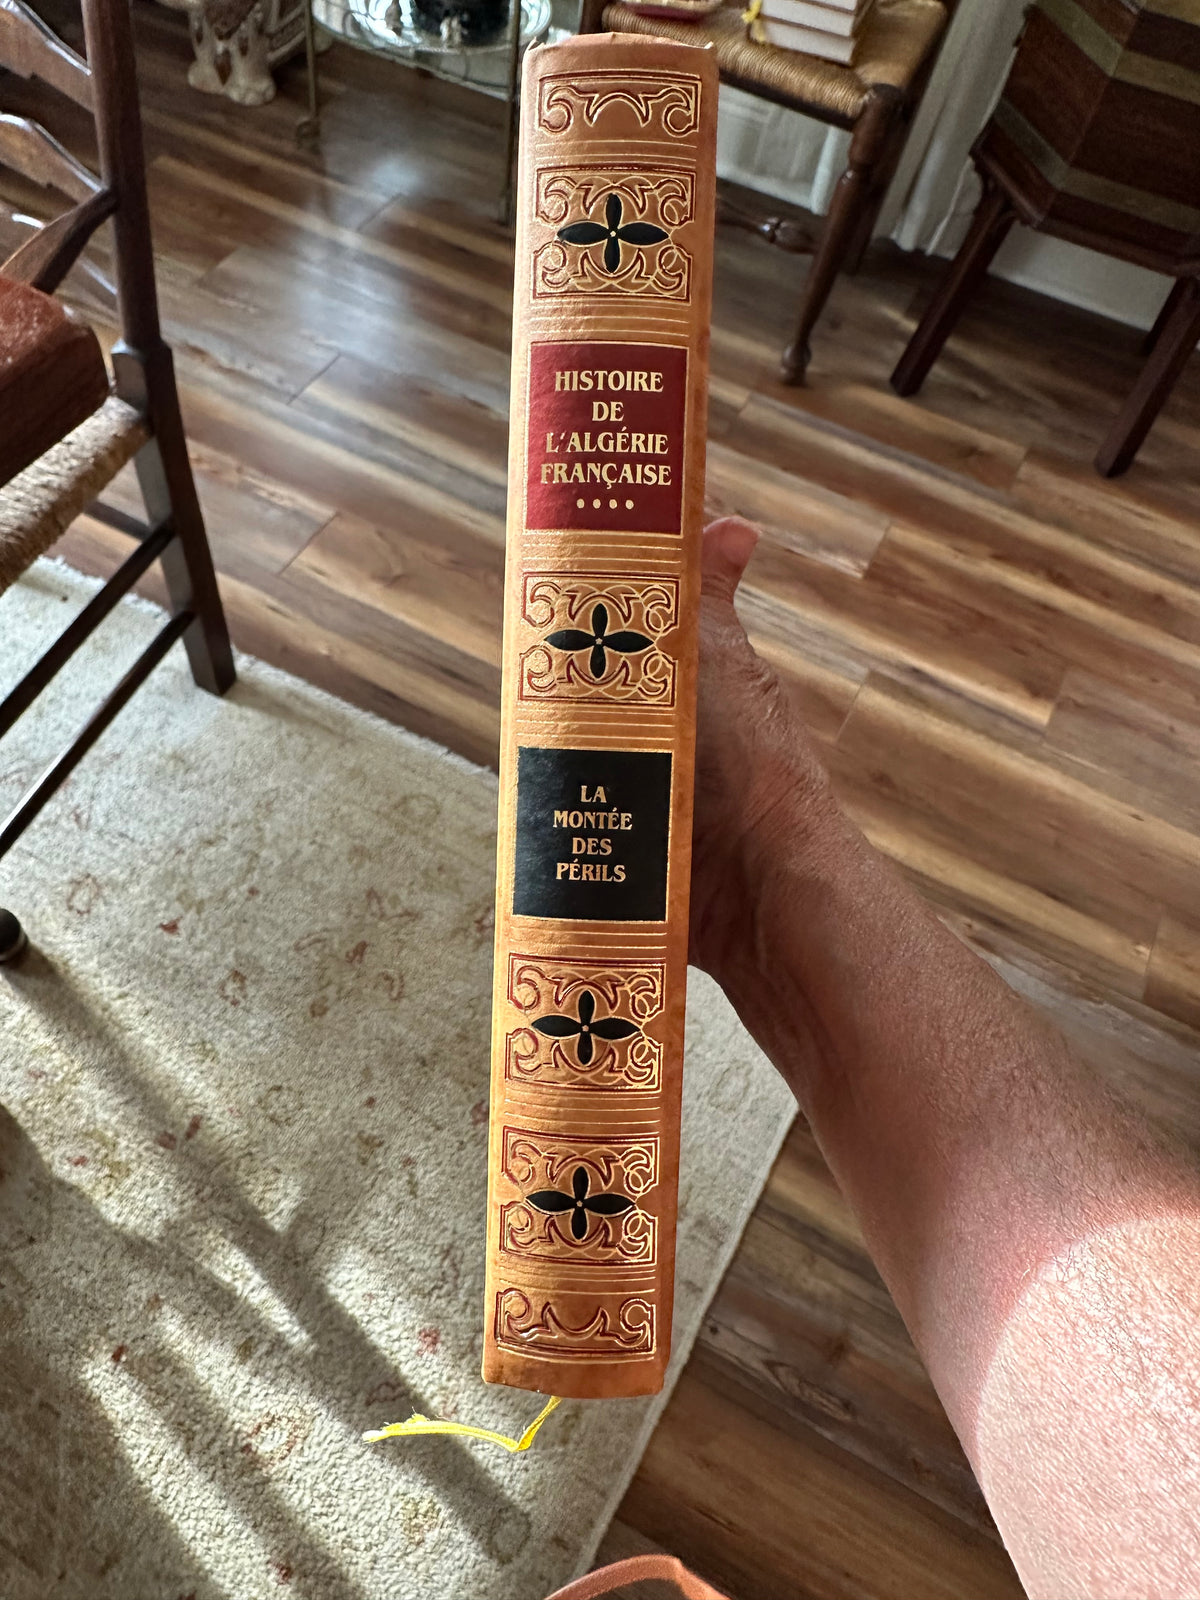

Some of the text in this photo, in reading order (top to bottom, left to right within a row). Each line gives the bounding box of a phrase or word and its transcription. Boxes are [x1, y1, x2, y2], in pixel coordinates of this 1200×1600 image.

[555, 370, 664, 393] HISTOIRE
[592, 401, 625, 422] DE
[546, 426, 669, 455] L'ALGÉRIE
[540, 463, 672, 490] FRANÇAISE
[580, 785, 607, 803] LA
[552, 807, 633, 831] MONTÉE
[572, 837, 613, 856] DES
[555, 859, 627, 882] PÉRILS
